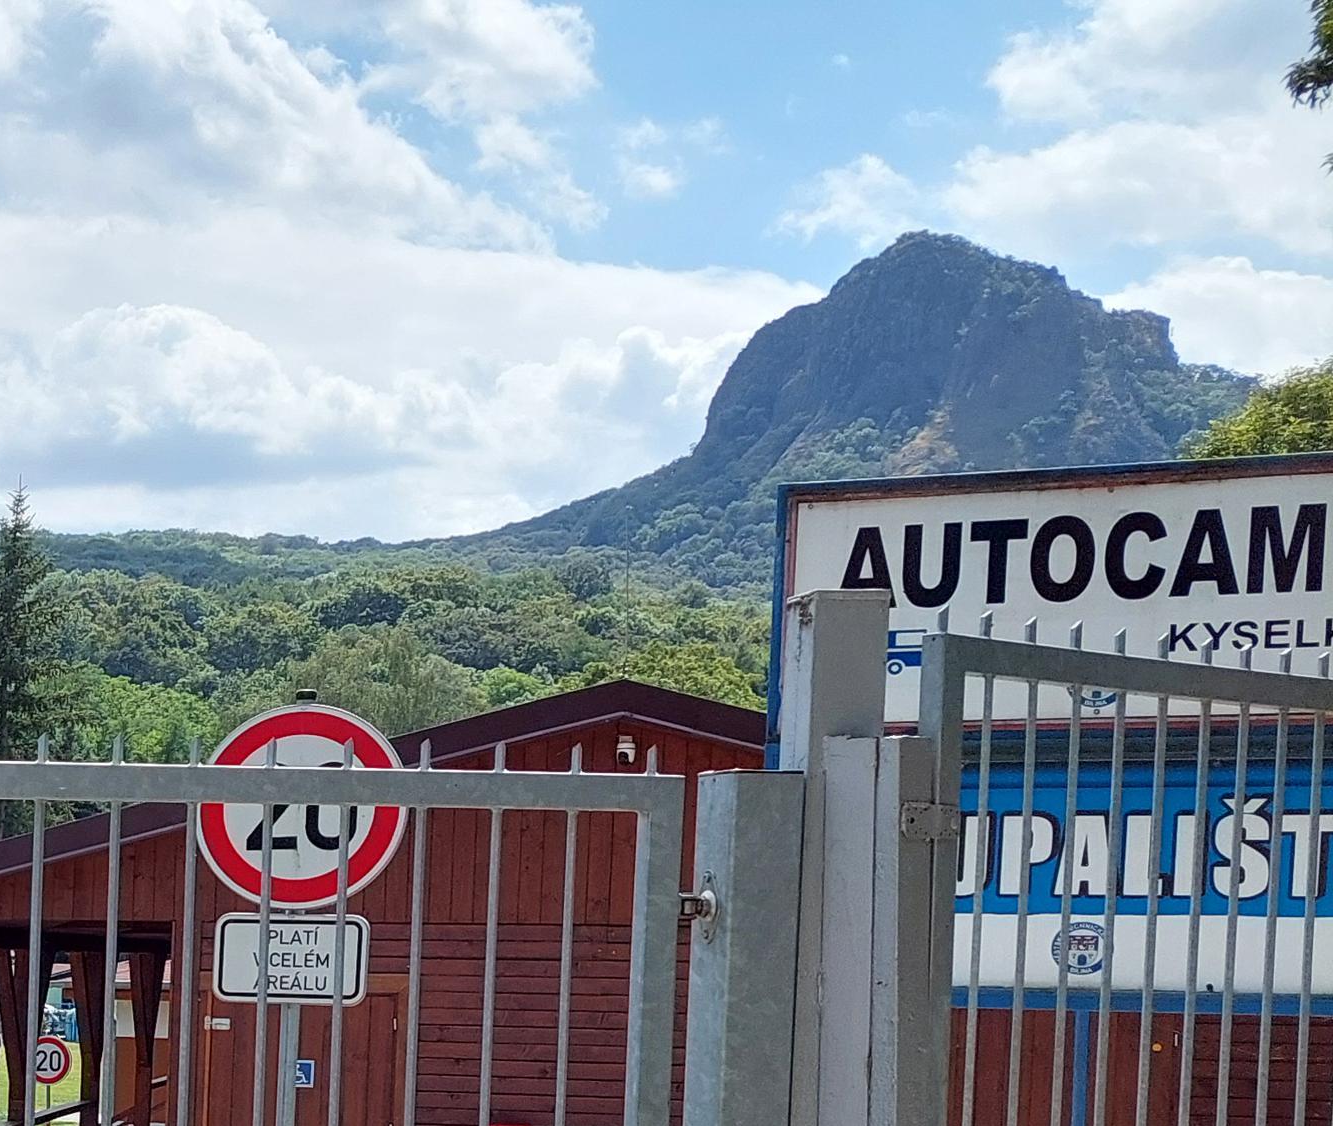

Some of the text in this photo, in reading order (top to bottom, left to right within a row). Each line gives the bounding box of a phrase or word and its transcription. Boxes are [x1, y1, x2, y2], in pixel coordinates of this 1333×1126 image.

[840, 503, 1328, 609] AUTOCAM
[954, 794, 1333, 900] UPALIŠT
[268, 926, 320, 946] PLATÍ
[269, 949, 330, 968] CELÉM
[36, 1049, 61, 1072] 20
